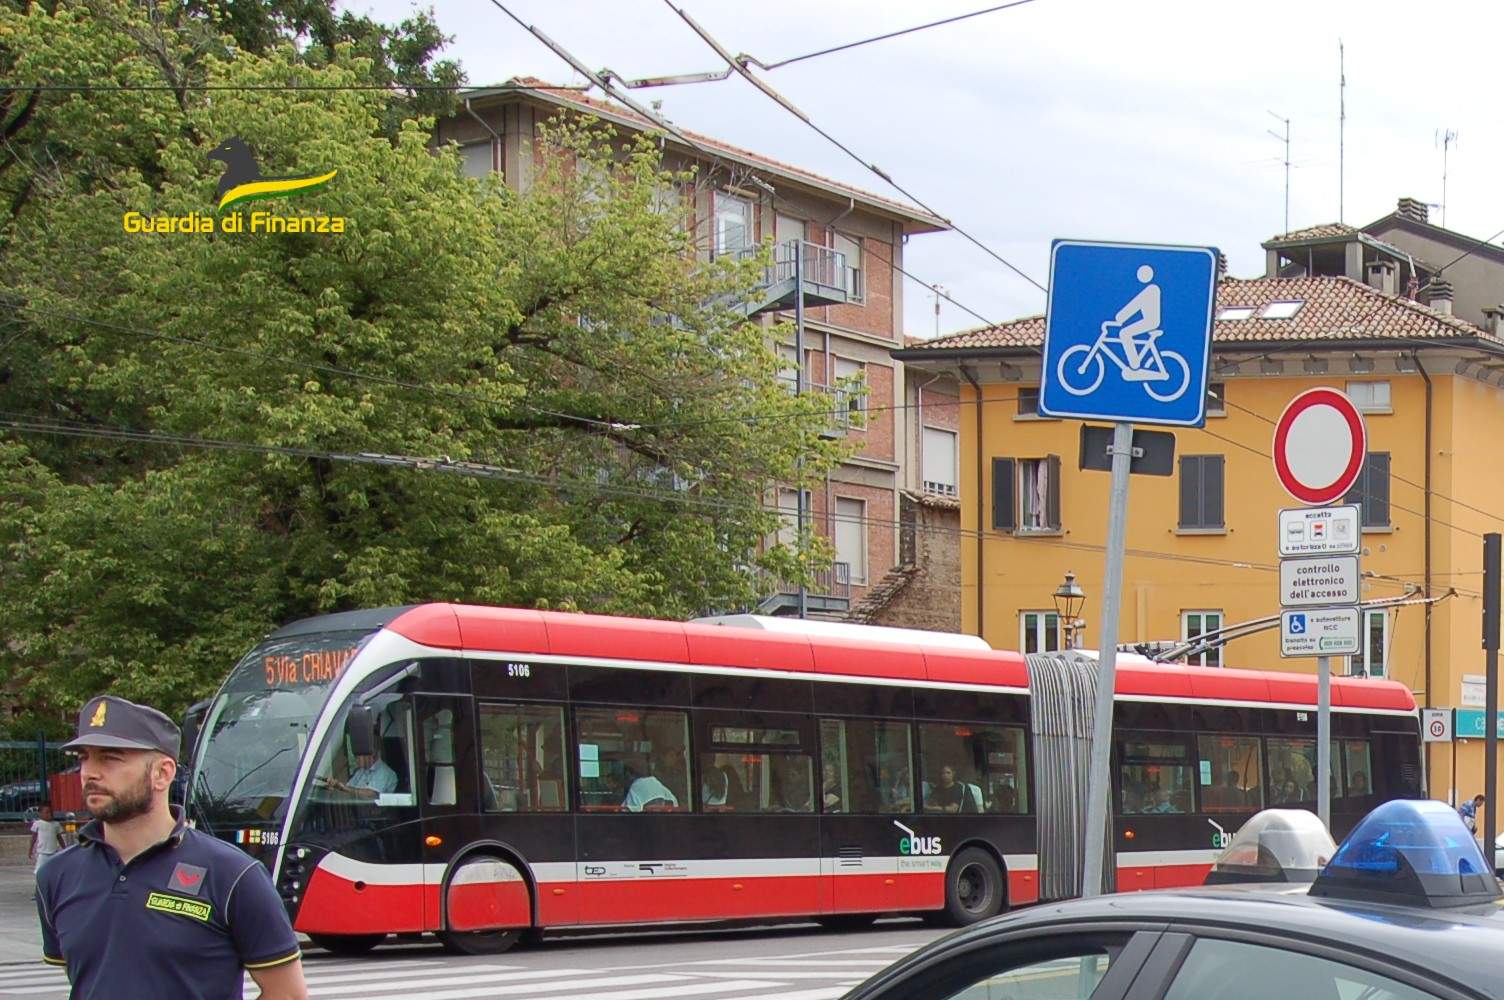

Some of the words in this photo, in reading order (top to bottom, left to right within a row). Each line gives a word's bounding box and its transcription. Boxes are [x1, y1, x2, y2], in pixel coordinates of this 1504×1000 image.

[1296, 563, 1340, 574] controllo
[1292, 577, 1345, 587] elettronico
[1289, 589, 1348, 599] dell'accesso
[508, 663, 530, 677] 5106
[261, 831, 279, 845] 5106
[899, 829, 942, 855] ebus
